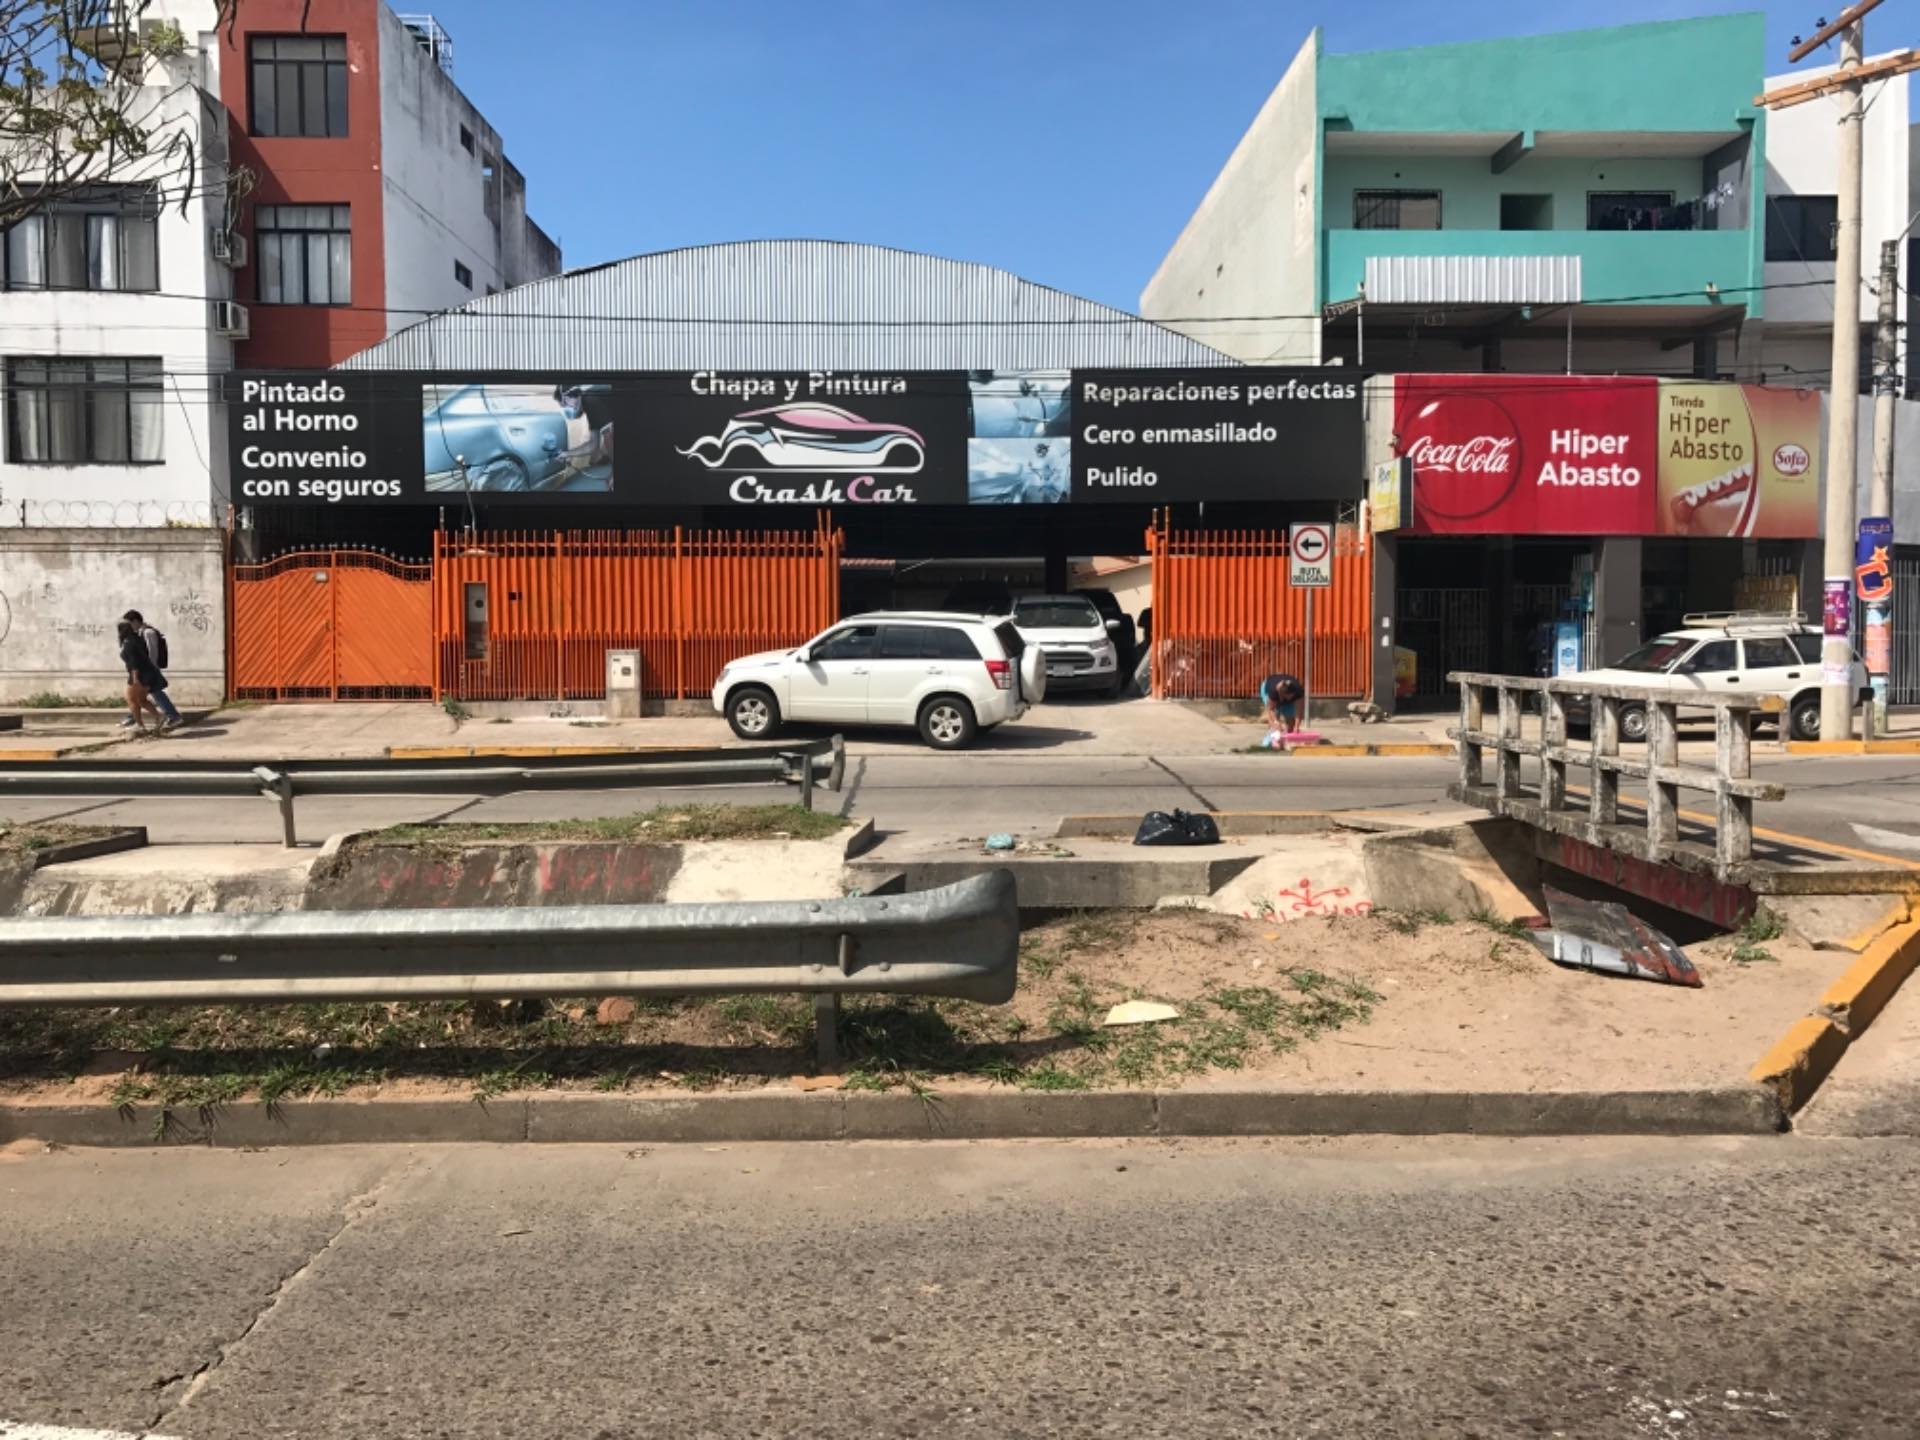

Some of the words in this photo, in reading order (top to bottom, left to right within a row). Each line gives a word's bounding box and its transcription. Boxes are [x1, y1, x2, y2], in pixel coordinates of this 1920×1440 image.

[242, 378, 346, 403] Pintado
[690, 371, 776, 401] Chapa
[783, 379, 800, 401] y
[808, 371, 907, 396] Pintura
[1083, 380, 1240, 408] Reparaciones
[1247, 378, 1357, 406] perfectas
[1670, 395, 1705, 408] Tienda
[242, 407, 266, 432] al
[274, 408, 359, 432] Horno
[1670, 409, 1731, 438] Hiper
[1083, 424, 1136, 445] Cero
[1141, 421, 1278, 444] enmasillado
[1551, 428, 1630, 459] Hiper
[241, 444, 367, 469] Convenio
[1406, 435, 1517, 473] Coca-Cola
[1670, 436, 1743, 461] Abasto
[1086, 466, 1158, 487] Pulido
[1536, 460, 1641, 487] Abasto
[242, 479, 291, 497] con
[297, 479, 402, 503] seguros
